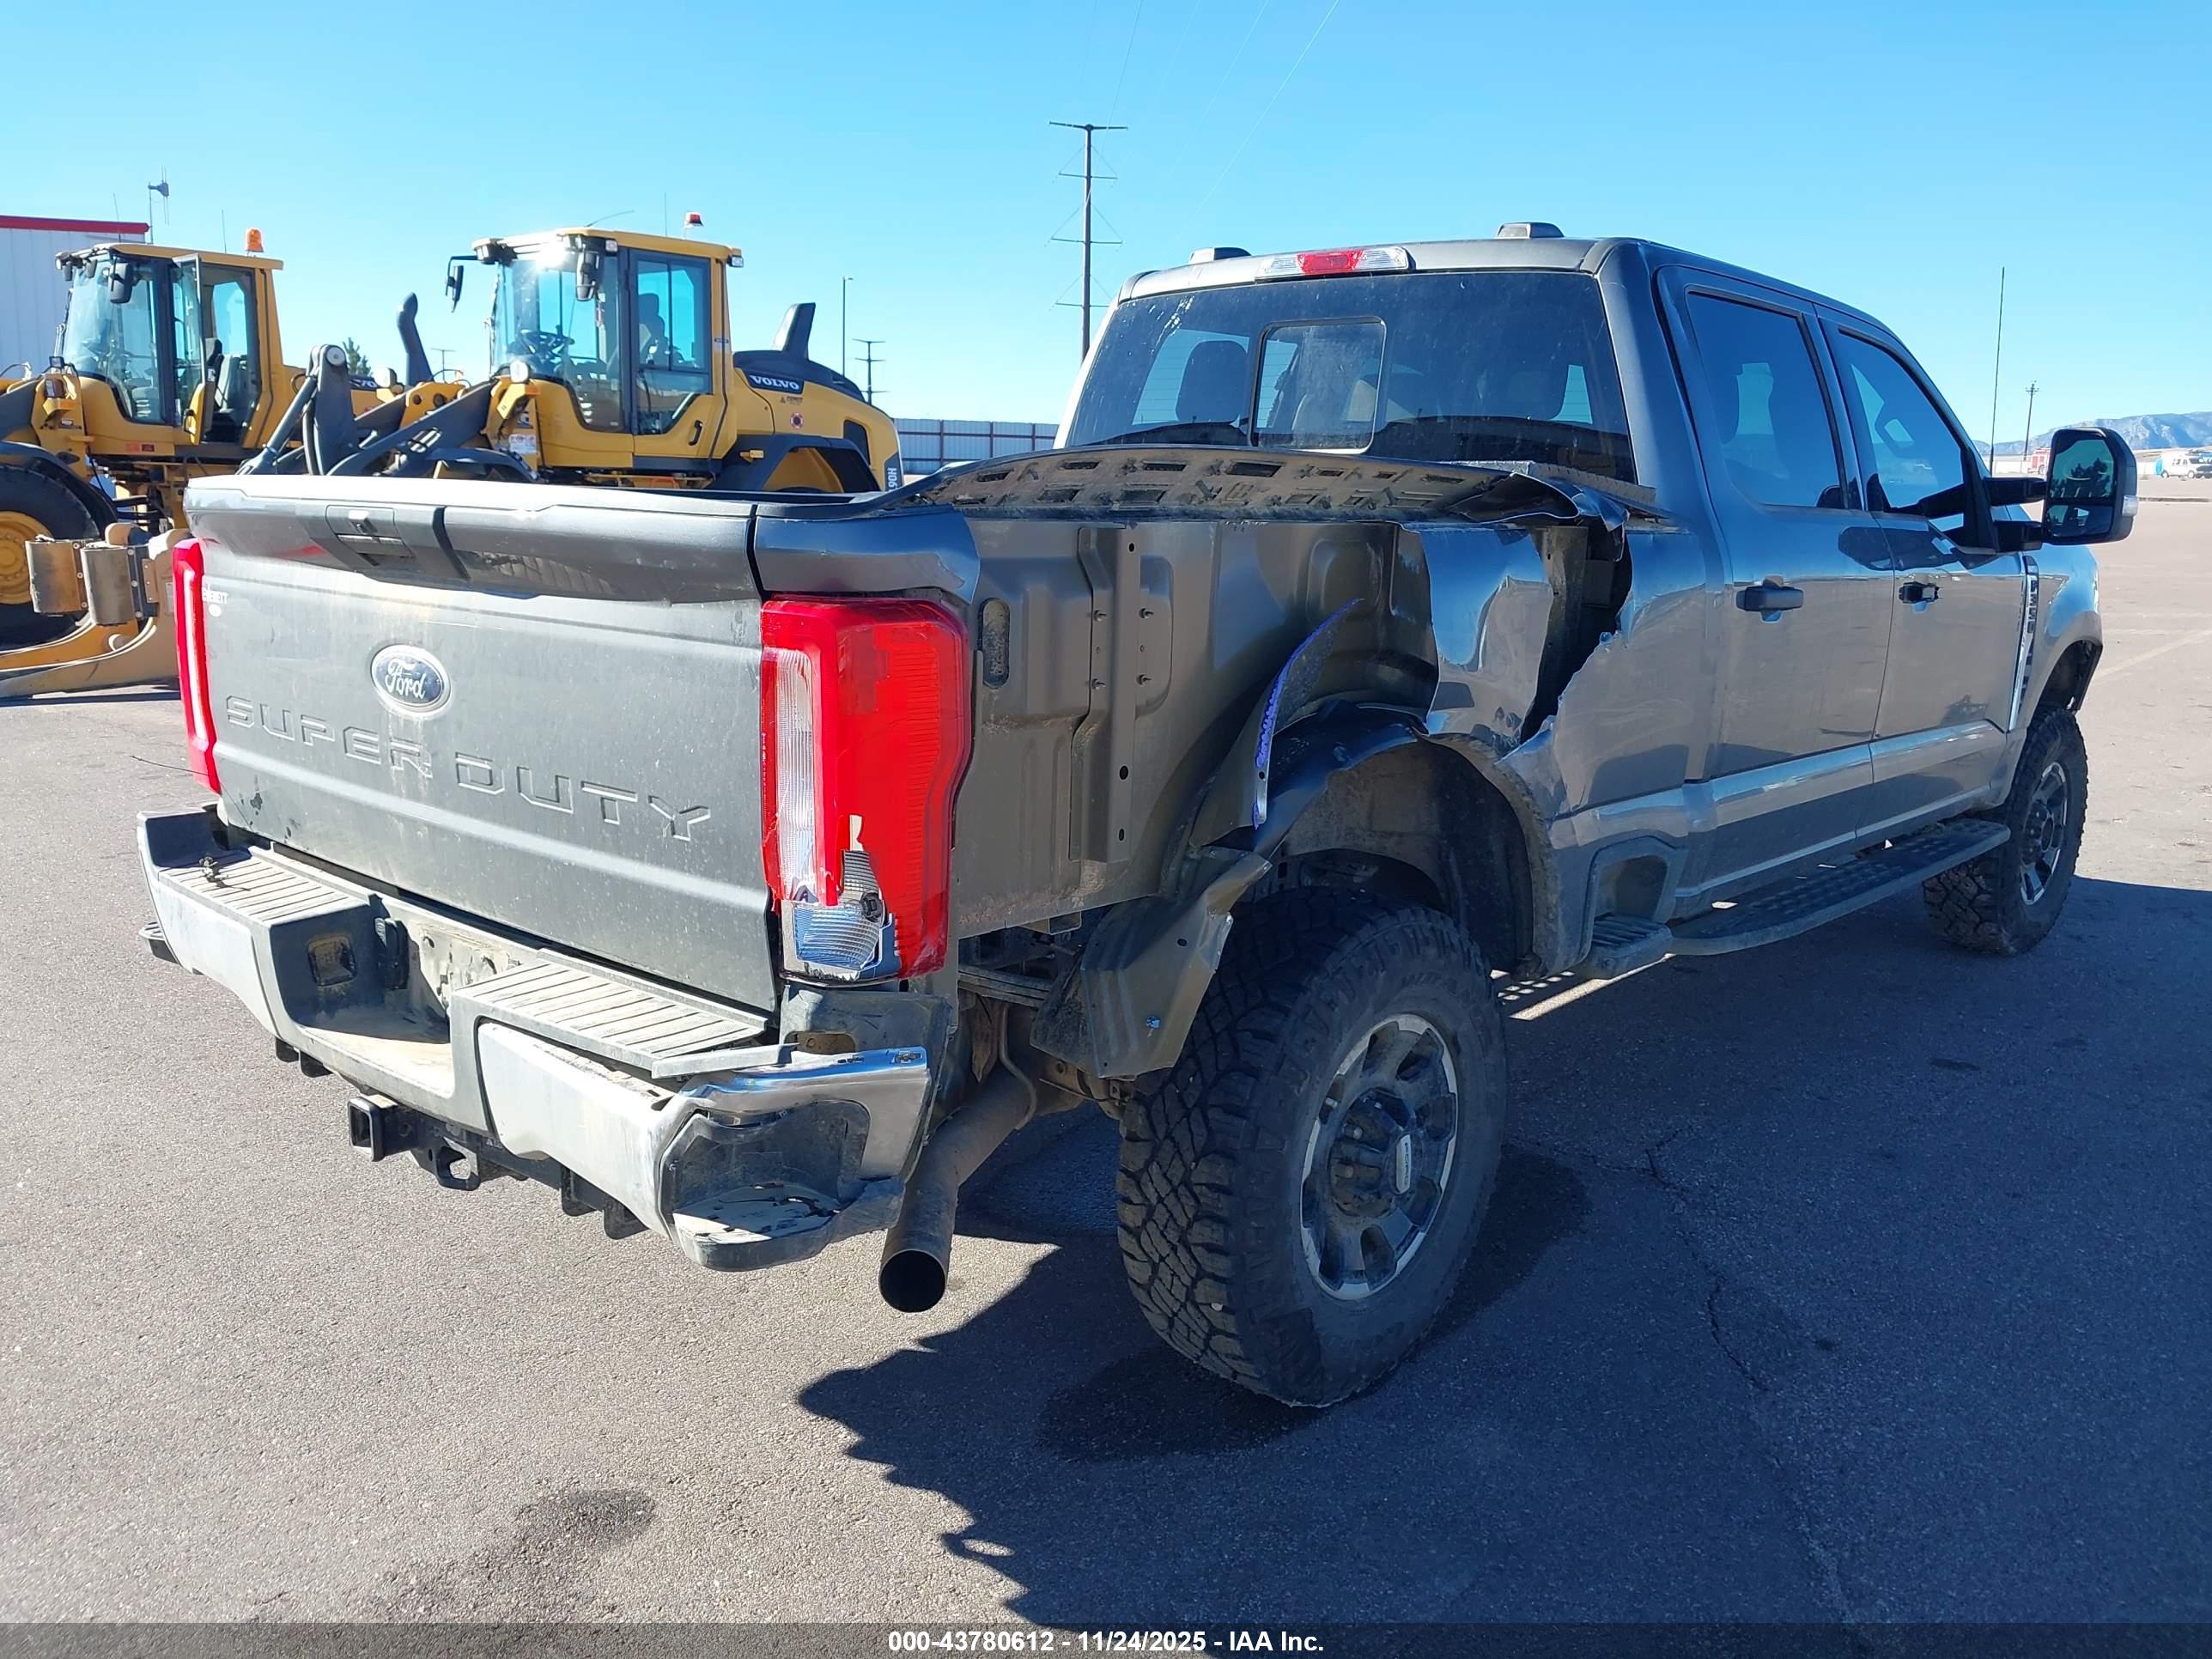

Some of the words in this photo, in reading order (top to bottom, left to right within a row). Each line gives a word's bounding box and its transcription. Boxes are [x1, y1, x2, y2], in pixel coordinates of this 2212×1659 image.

[749, 374, 799, 390] VOLVO
[887, 467, 898, 490] 90H
[385, 658, 427, 700] Ford
[226, 695, 434, 779] SUPER
[455, 751, 712, 842] DUTY
